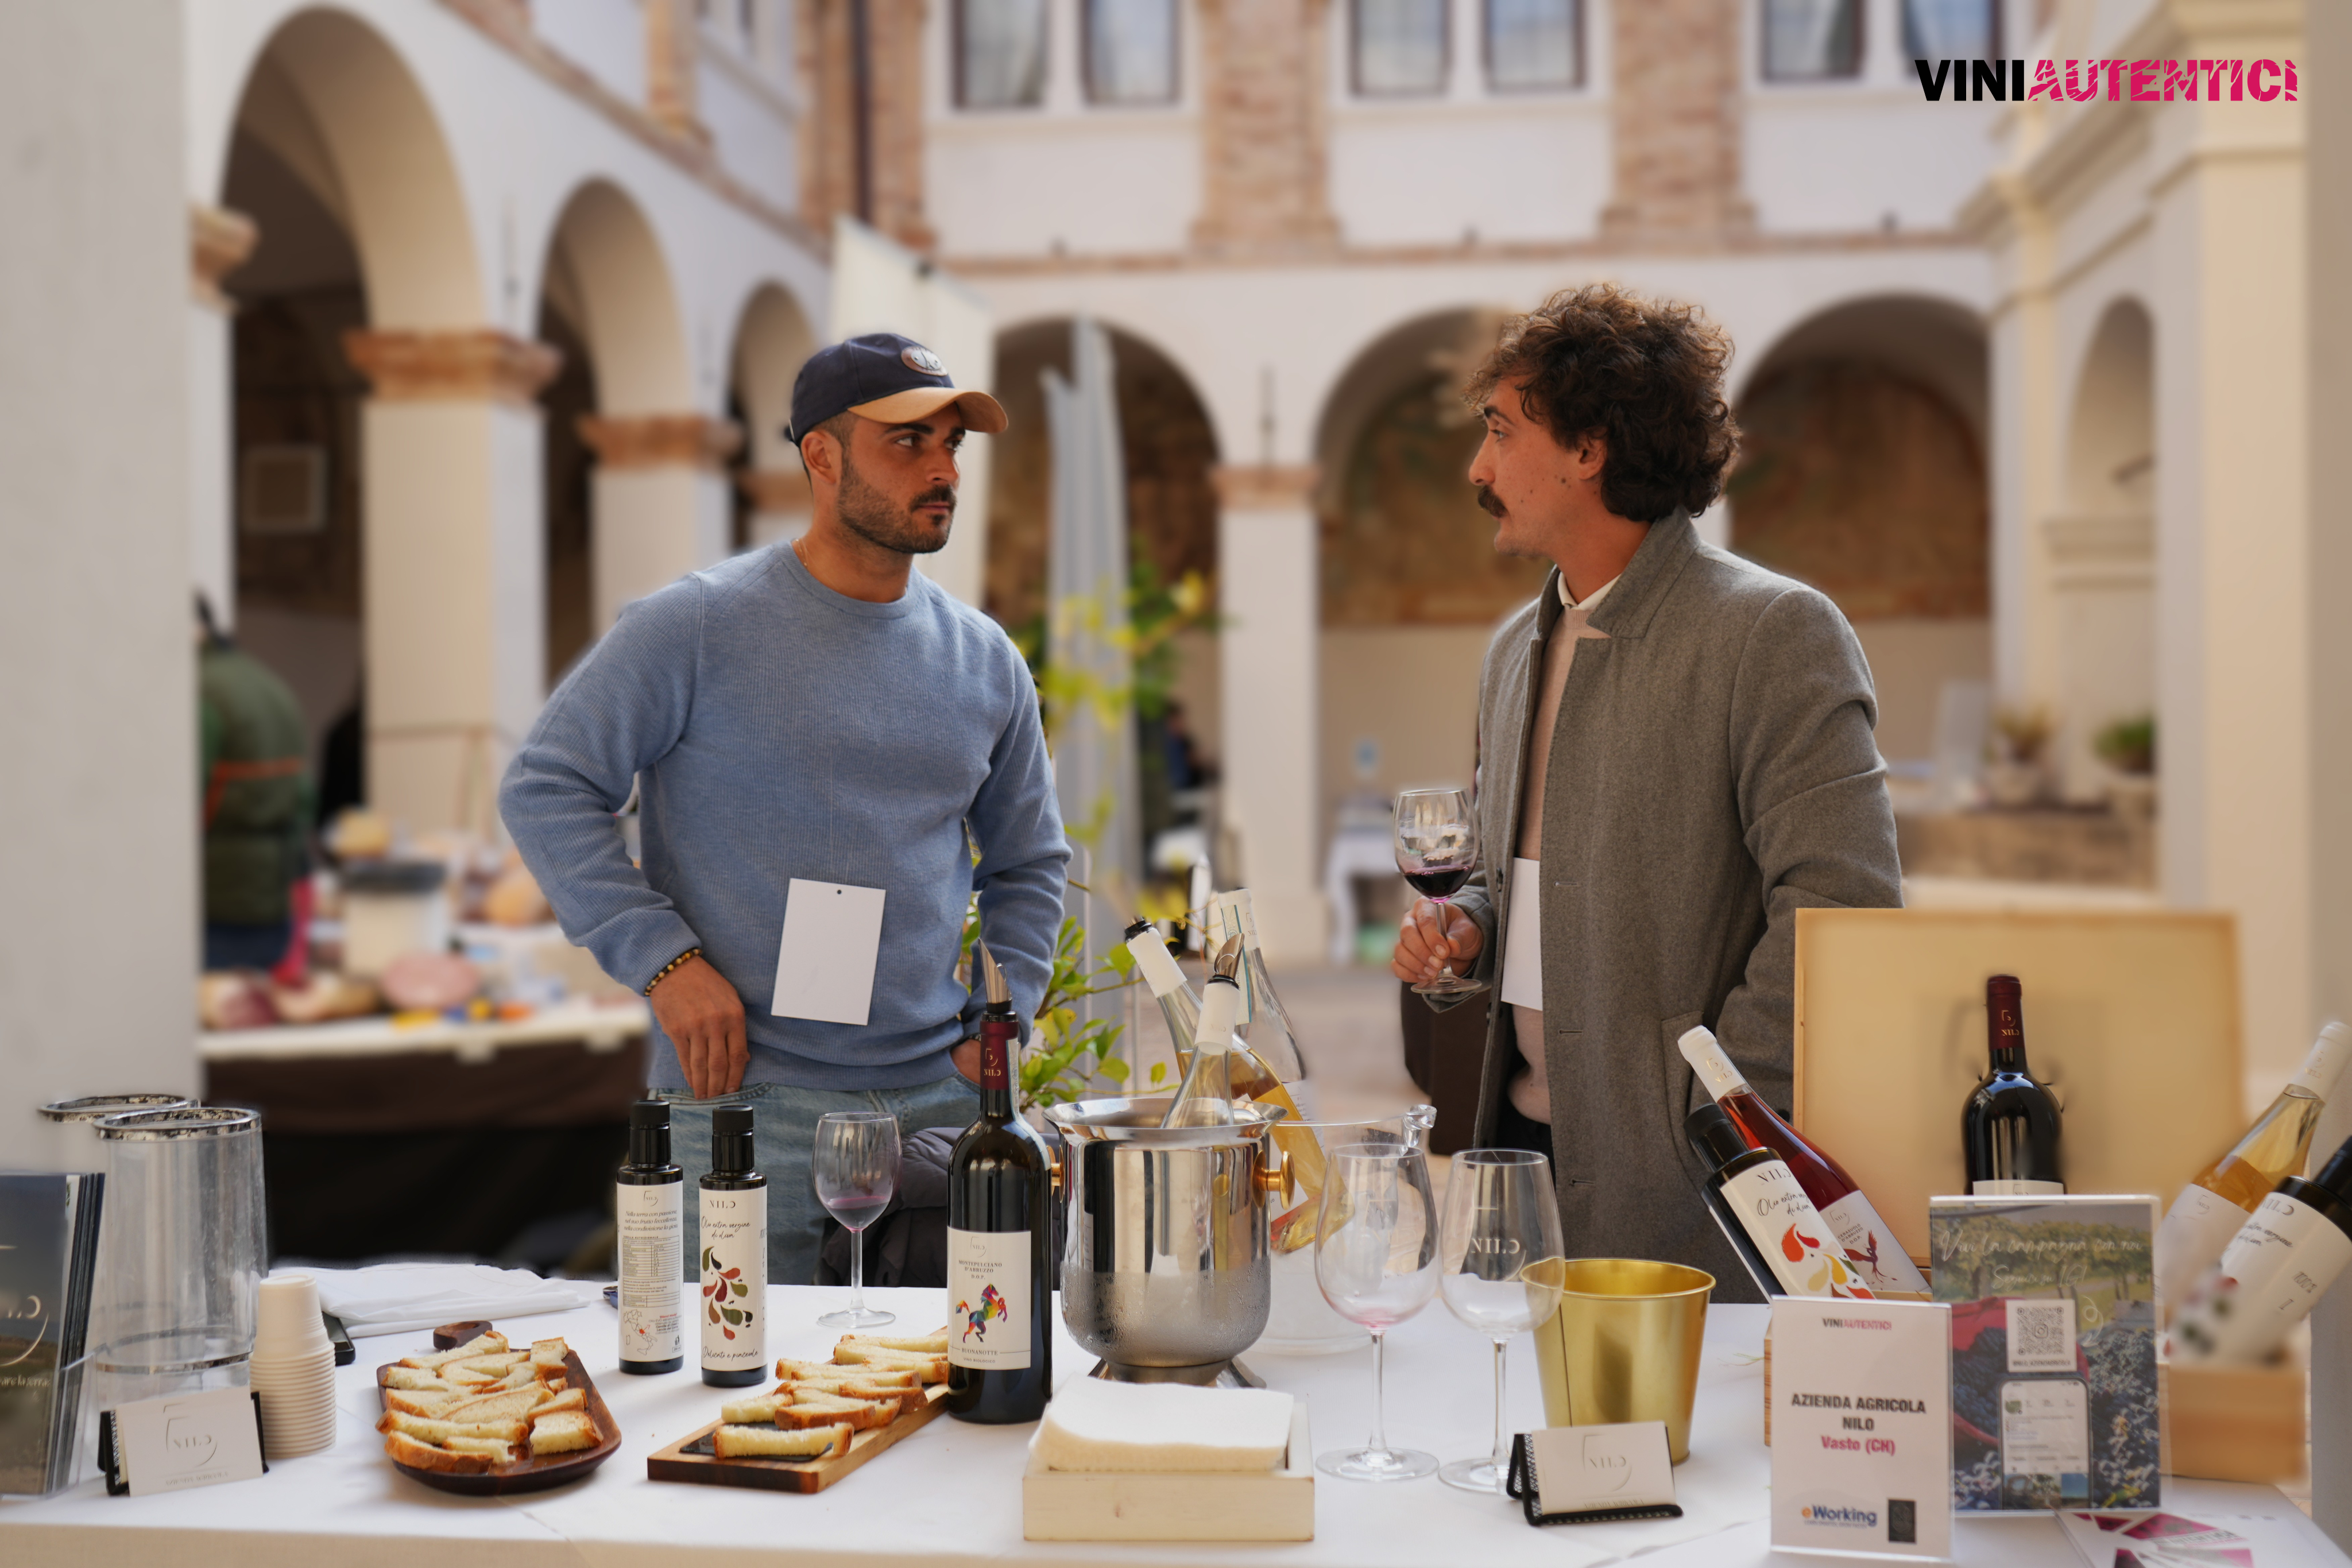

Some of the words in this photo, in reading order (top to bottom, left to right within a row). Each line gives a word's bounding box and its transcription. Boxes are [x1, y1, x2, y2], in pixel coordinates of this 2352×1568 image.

[1838, 1224, 1860, 1239] CERASUOLO
[1471, 1238, 1520, 1254] NILO
[2007, 1239, 2088, 1264] campagna
[958, 1260, 1002, 1268] MONTEPULCIANO
[961, 1348, 998, 1356] BUONANOTTE
[1792, 1393, 1852, 1410] AZIENDA
[1856, 1396, 1927, 1414] AGRICOLA
[1842, 1416, 1875, 1431] NILO
[1820, 1435, 1861, 1451] Vasto
[1866, 1438, 1895, 1456] (CH)
[1801, 1504, 1878, 1527] eWorking
